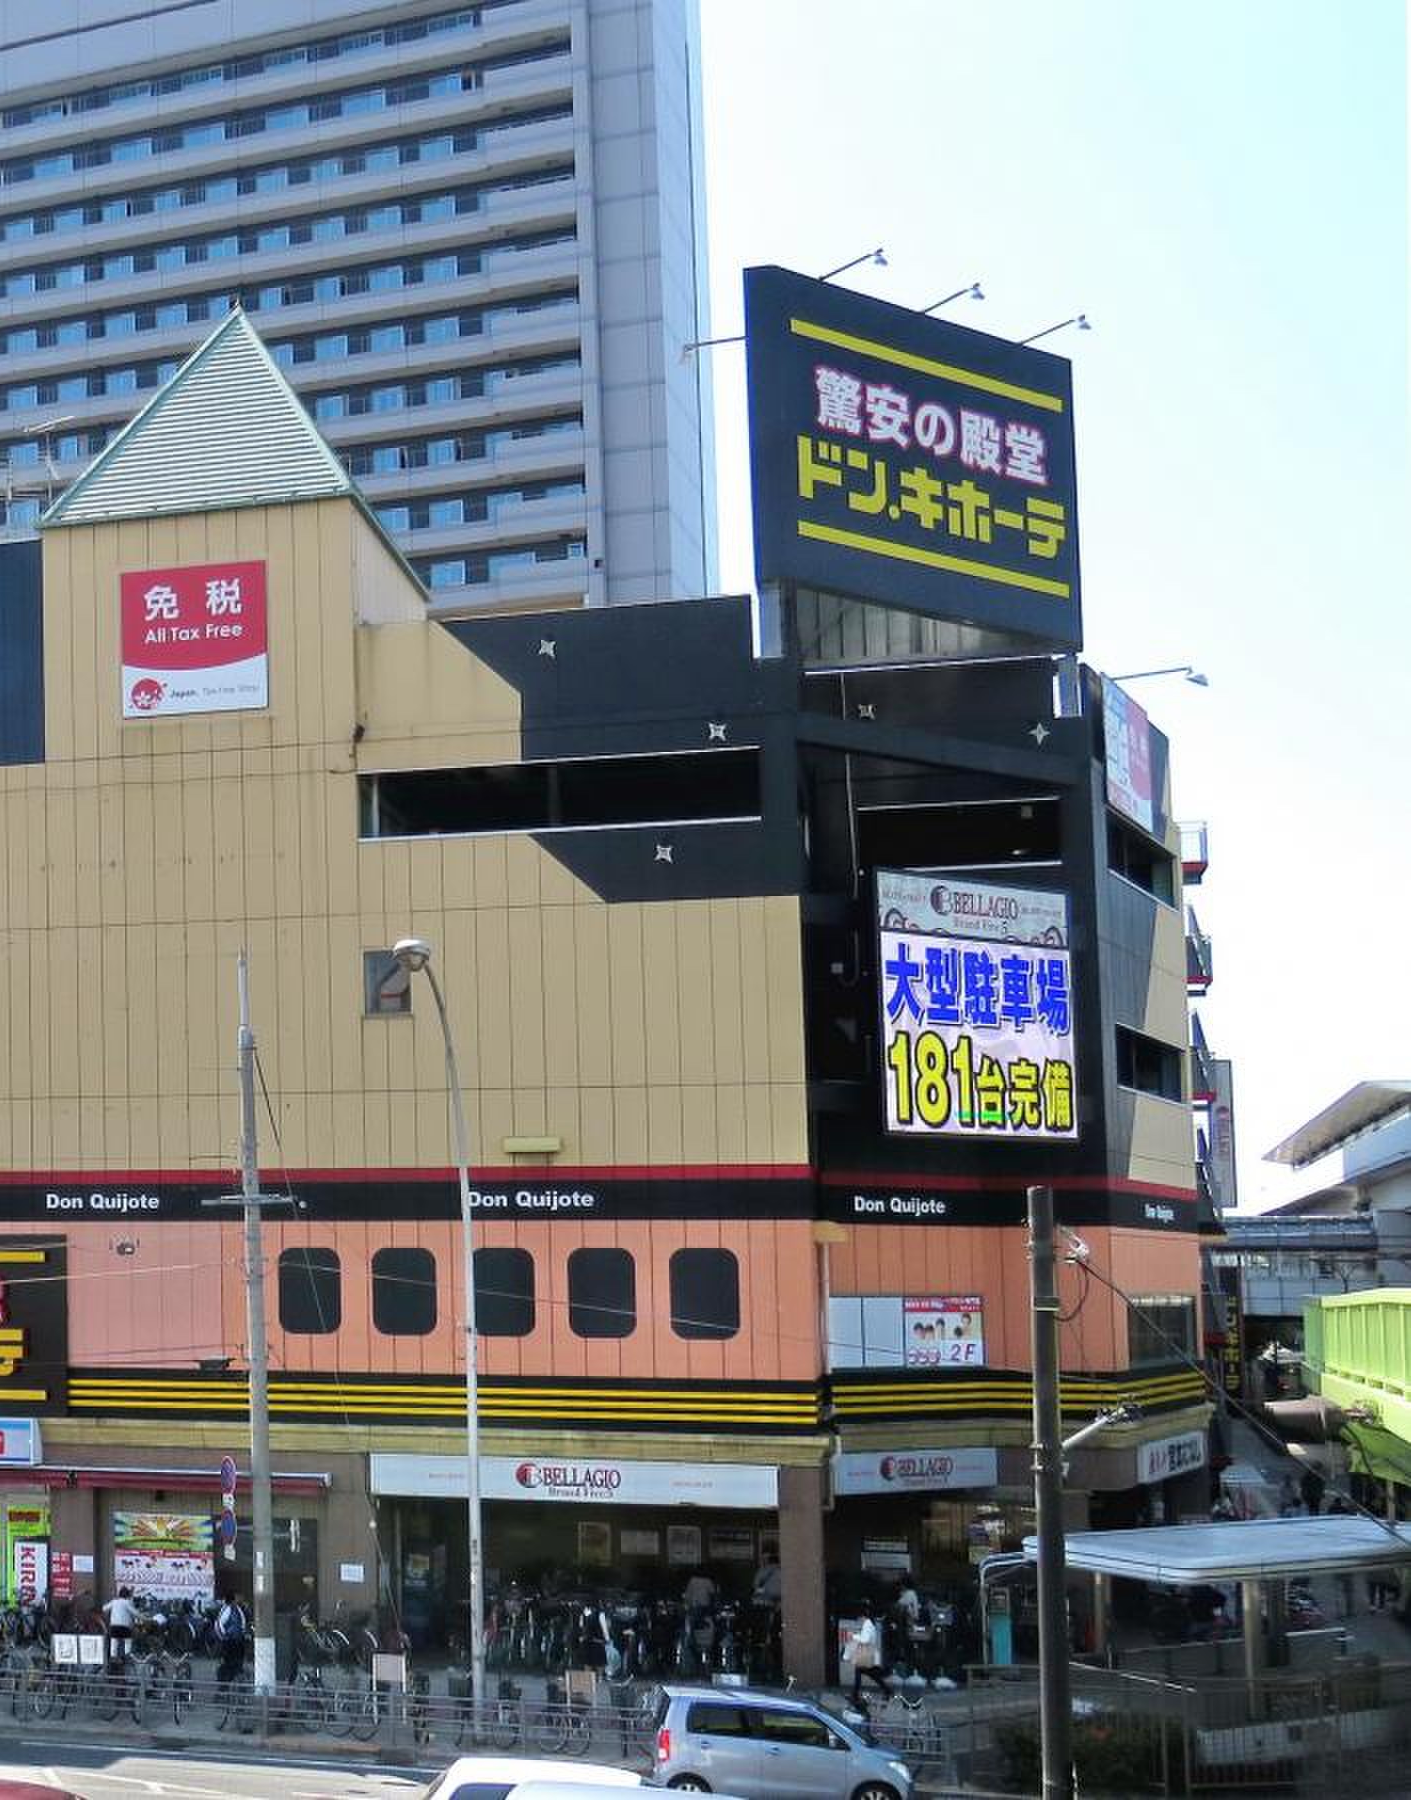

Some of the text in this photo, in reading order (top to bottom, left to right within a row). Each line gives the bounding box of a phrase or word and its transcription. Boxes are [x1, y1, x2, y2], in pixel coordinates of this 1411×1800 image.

[814, 366, 1048, 485] 驚安の殿堂
[145, 623, 243, 644] All Tax Free
[953, 891, 1018, 920] BELLAGIO
[885, 942, 1070, 1035] 大型駐車場
[887, 1030, 1073, 1132] 181台完備
[46, 1193, 159, 1212] Don Quijote
[468, 1190, 594, 1211] Don Quijote
[854, 1195, 945, 1216] Don Quijote
[951, 1344, 976, 1360] 2F
[542, 1466, 622, 1489] BELLAGIO
